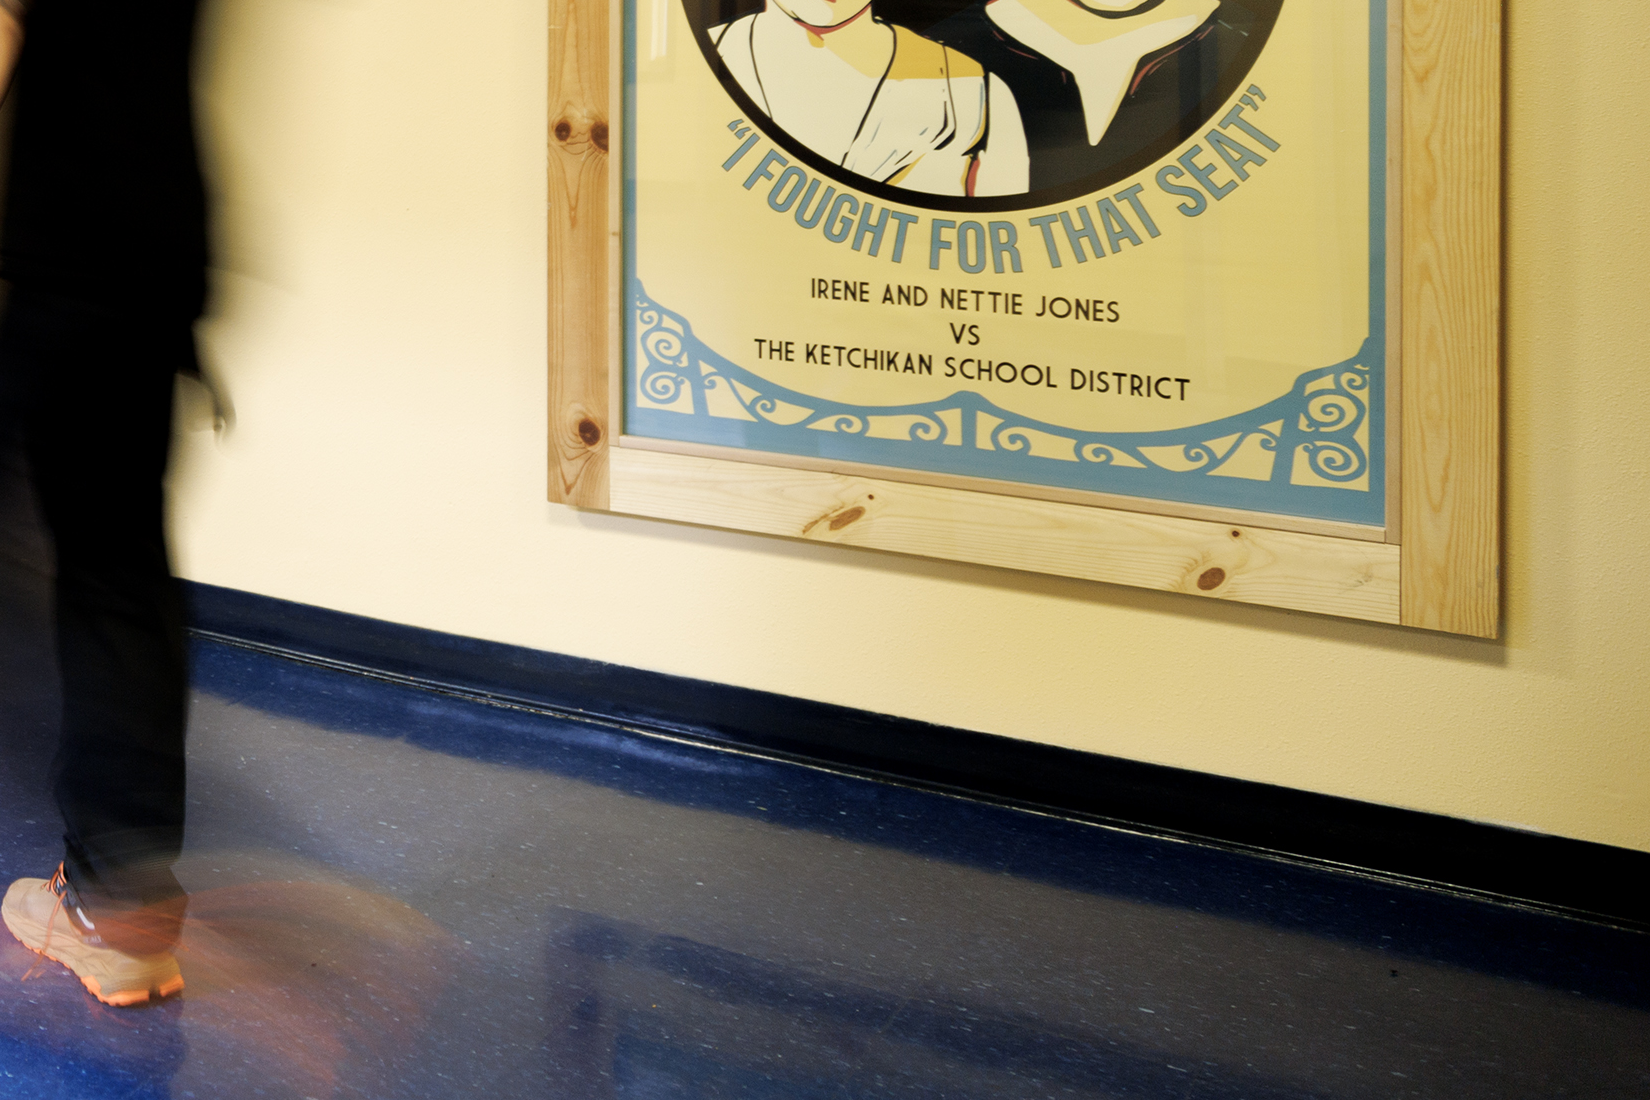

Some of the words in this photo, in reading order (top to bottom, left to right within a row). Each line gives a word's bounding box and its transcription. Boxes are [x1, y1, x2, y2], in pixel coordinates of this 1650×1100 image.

[742, 148, 919, 264] FOUGHT
[928, 218, 1024, 275] FOR
[1028, 182, 1162, 269] THAT
[1155, 83, 1282, 218] SEAT”
[811, 277, 870, 303] IRENE
[881, 283, 928, 307] AND
[940, 287, 1023, 316] NETTIE
[1035, 295, 1120, 323] JONES
[949, 322, 980, 346] VS
[754, 338, 795, 362] THE
[805, 343, 932, 376] KETCHIKAN
[944, 356, 1058, 389] SCHOOL
[1070, 367, 1190, 401] DISTRICT
